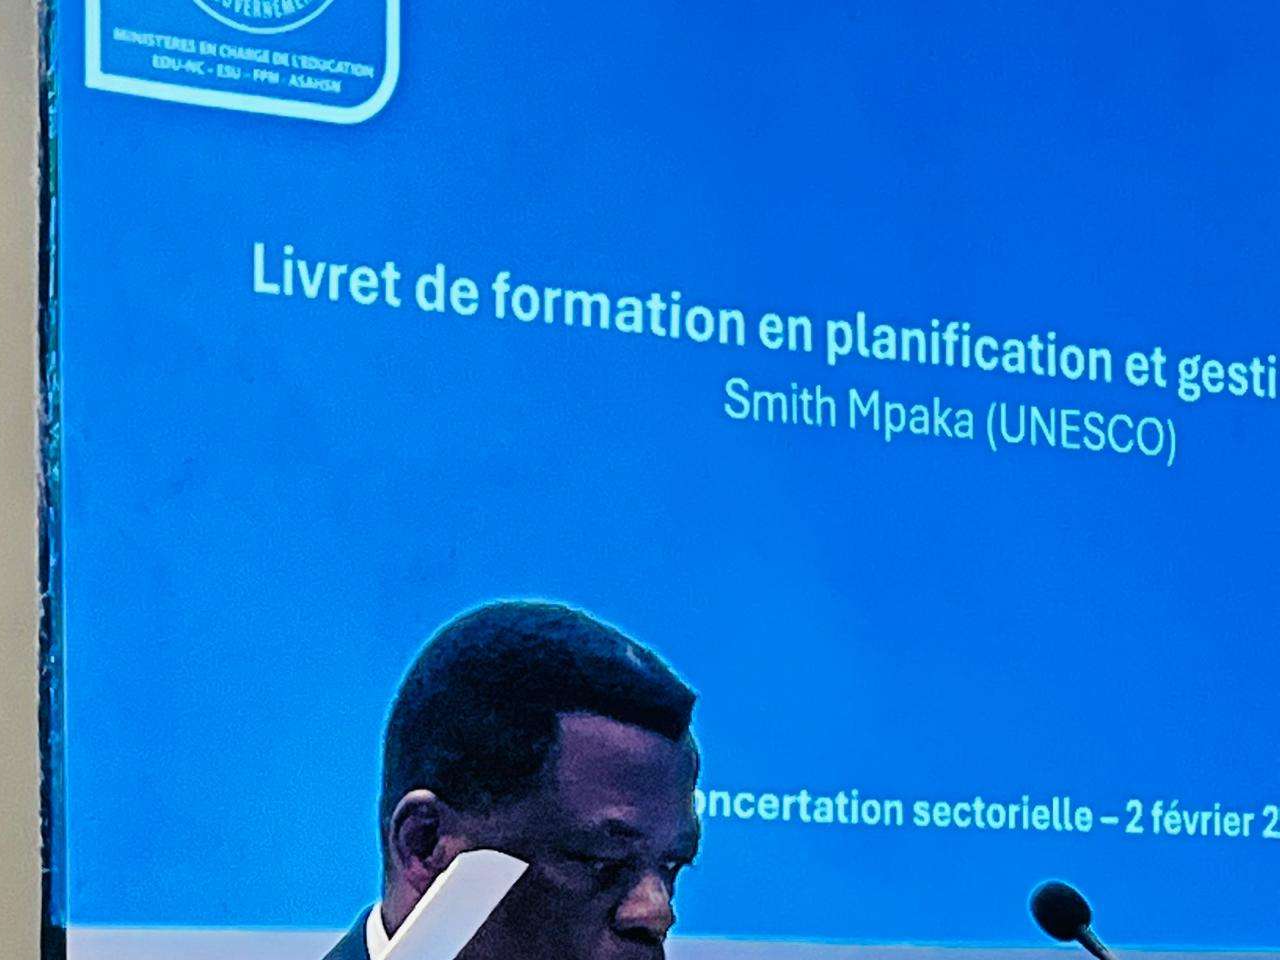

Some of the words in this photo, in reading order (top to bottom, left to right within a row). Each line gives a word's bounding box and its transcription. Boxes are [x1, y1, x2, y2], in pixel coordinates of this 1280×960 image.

[200, 41, 216, 57] EN
[219, 44, 269, 64] CHARGE
[272, 51, 289, 67] DE
[253, 242, 402, 307] Livret
[415, 263, 479, 316] de
[491, 271, 746, 346] formation
[758, 313, 813, 352] en
[826, 311, 1112, 383] planification
[1125, 346, 1167, 388] et
[1177, 354, 1277, 402] gesti
[724, 377, 836, 427] Smith
[848, 388, 974, 442] Mpaka
[986, 402, 1177, 467] (UNESCO)
[913, 794, 1093, 832] sectorielle
[1125, 799, 1144, 834] 2
[1151, 799, 1256, 837] février
